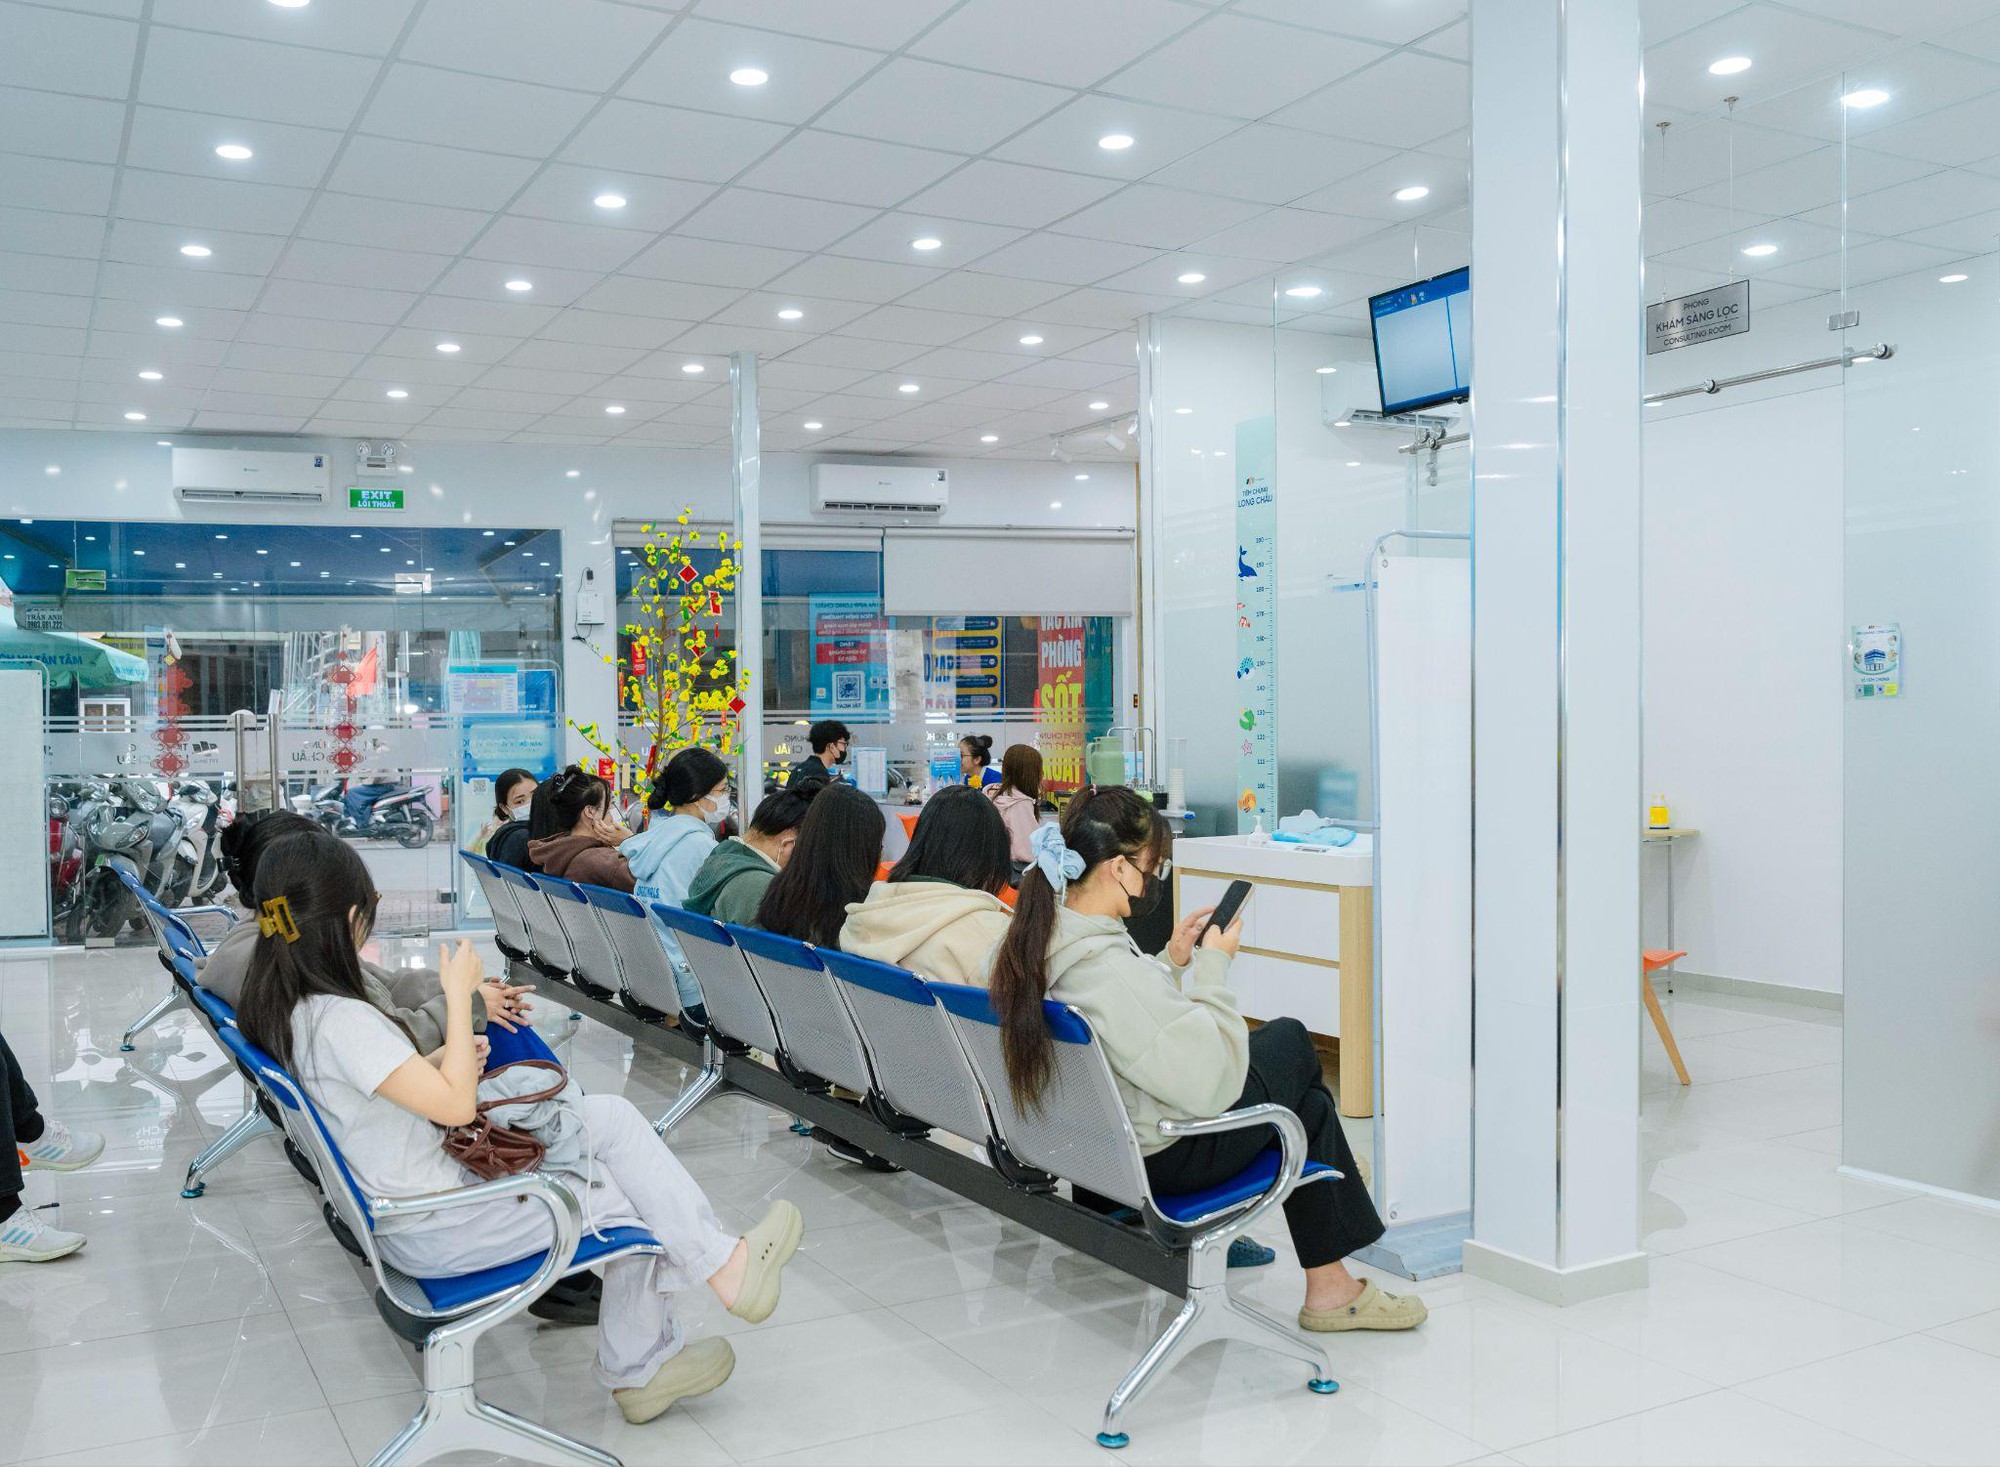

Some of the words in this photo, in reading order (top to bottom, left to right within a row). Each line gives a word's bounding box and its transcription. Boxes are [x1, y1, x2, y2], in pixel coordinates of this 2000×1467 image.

[1656, 316, 1684, 332] KHÁM
[1686, 310, 1714, 325] SÀNG
[1717, 304, 1738, 319] LỌC
[1663, 329, 1706, 346] CONSULTING
[1708, 324, 1731, 335] ROOM
[361, 490, 392, 500] EXIT
[1041, 633, 1082, 668] PHÒNG
[1041, 671, 1082, 723] SỐT
